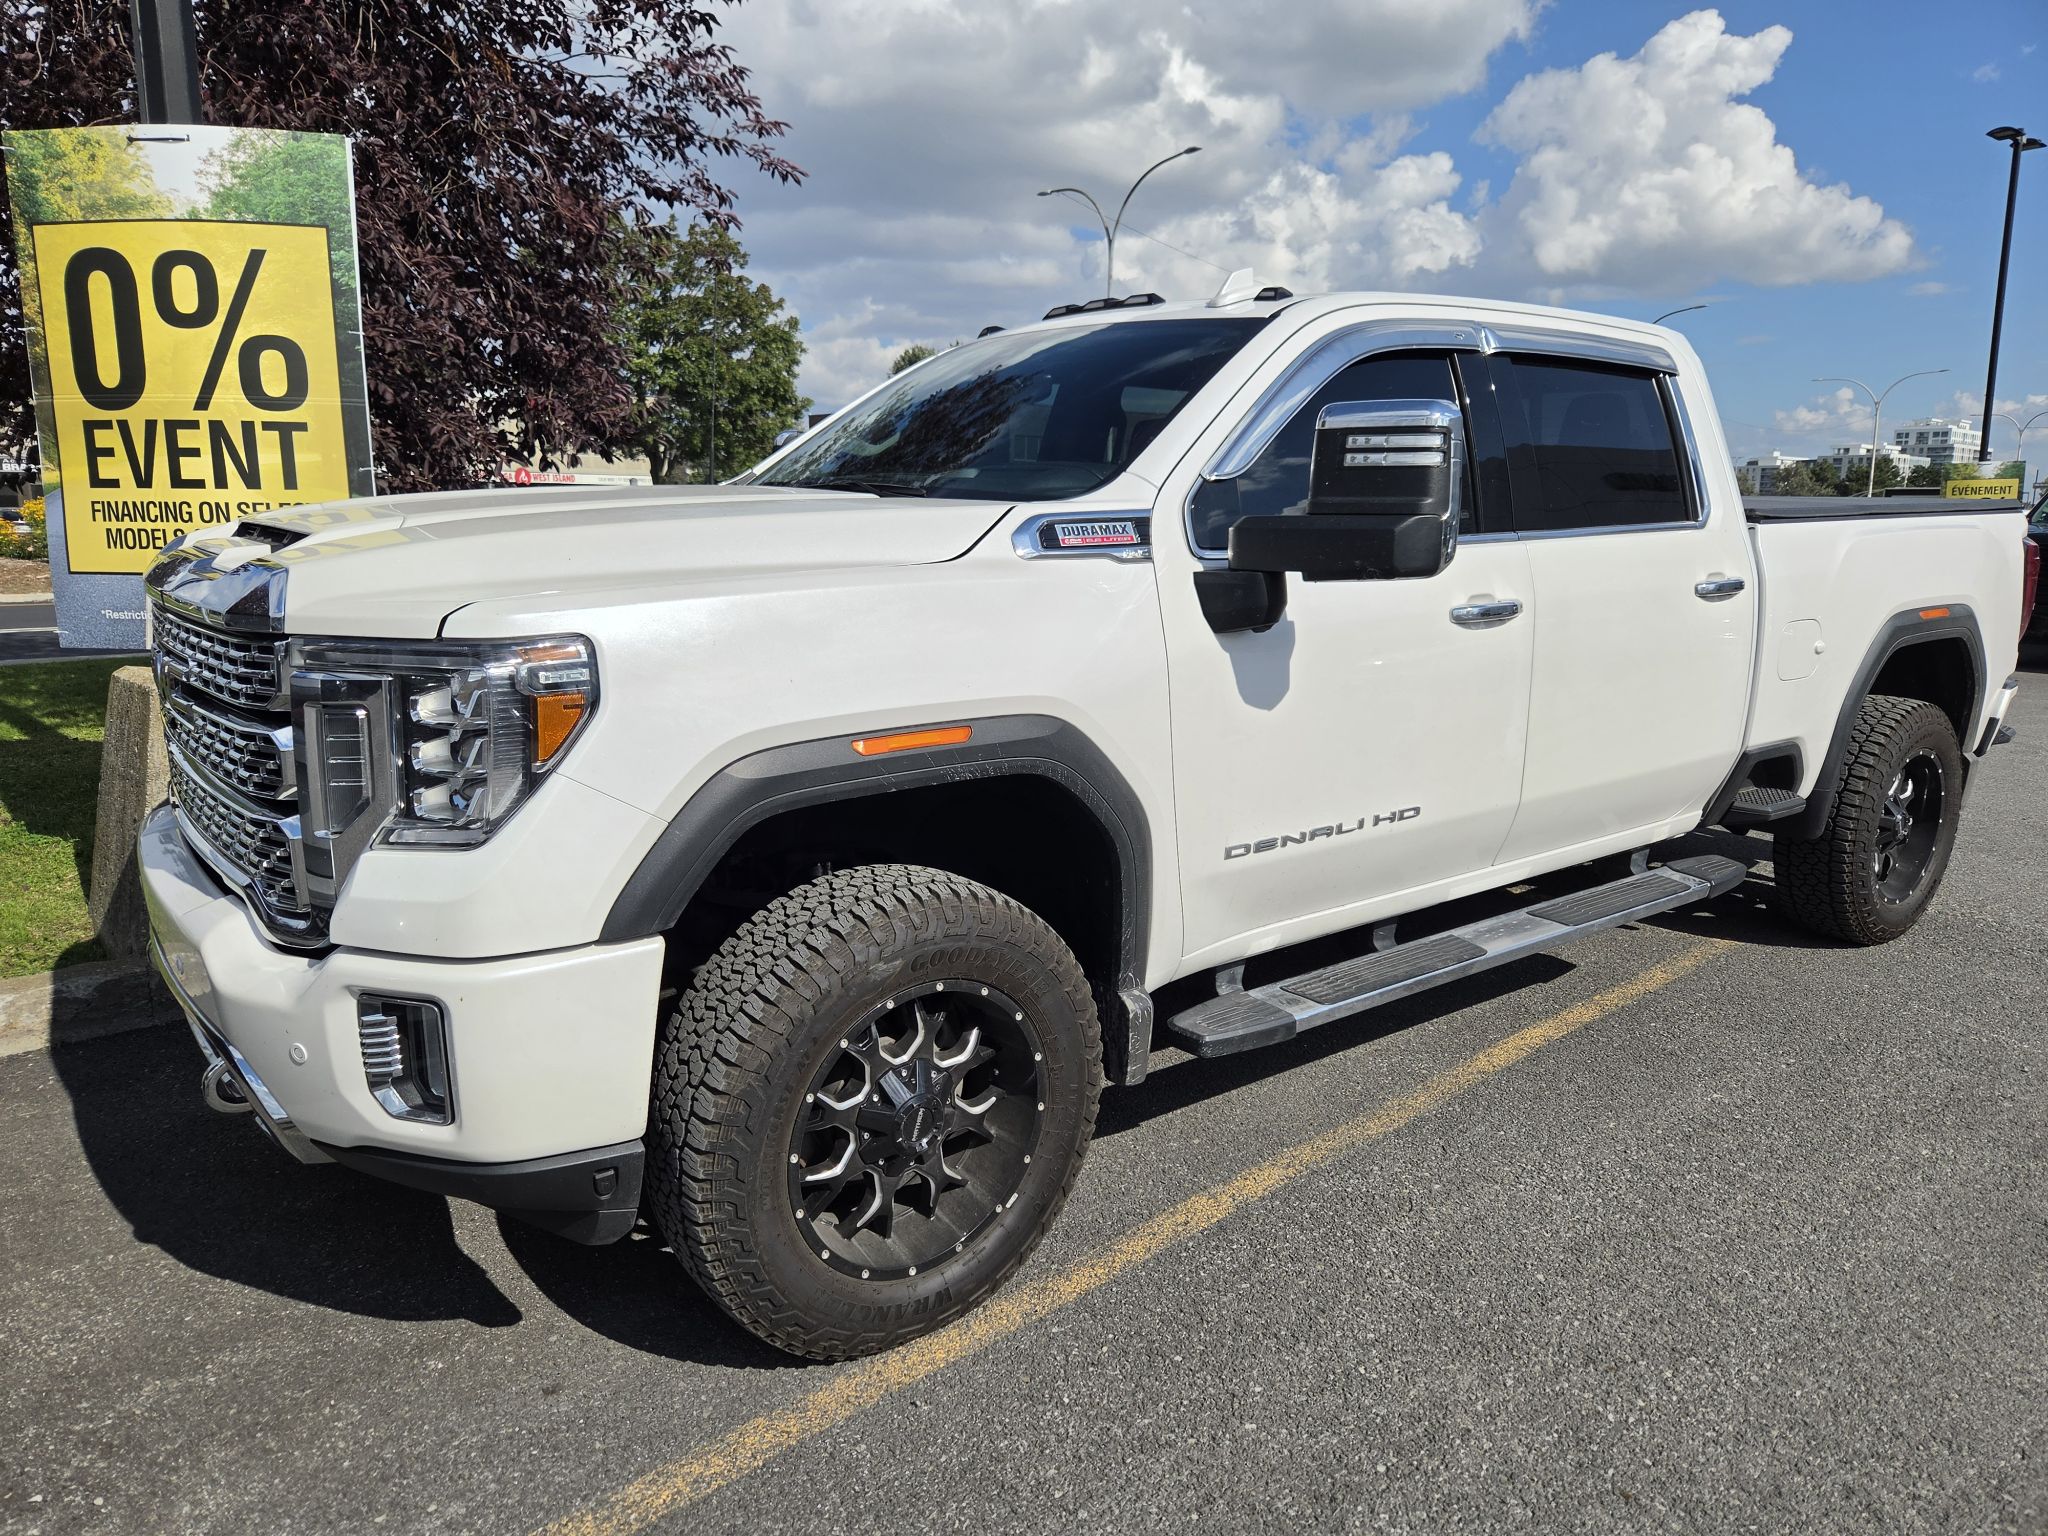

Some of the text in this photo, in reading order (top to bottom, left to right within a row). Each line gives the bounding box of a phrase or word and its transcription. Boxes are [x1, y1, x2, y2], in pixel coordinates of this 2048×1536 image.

[64, 247, 309, 412] 0%
[82, 419, 309, 491] EVENT
[532, 473, 550, 482] WEST
[552, 474, 576, 483] ISLAND
[1951, 484, 2013, 496] ÉVÉNEMENT
[90, 500, 193, 524] FINANCING
[198, 501, 231, 524] ON
[1060, 524, 1129, 537] DURAMAX
[1223, 806, 1421, 861] DENALI HD
[910, 945, 1050, 998] GOODYEAR
